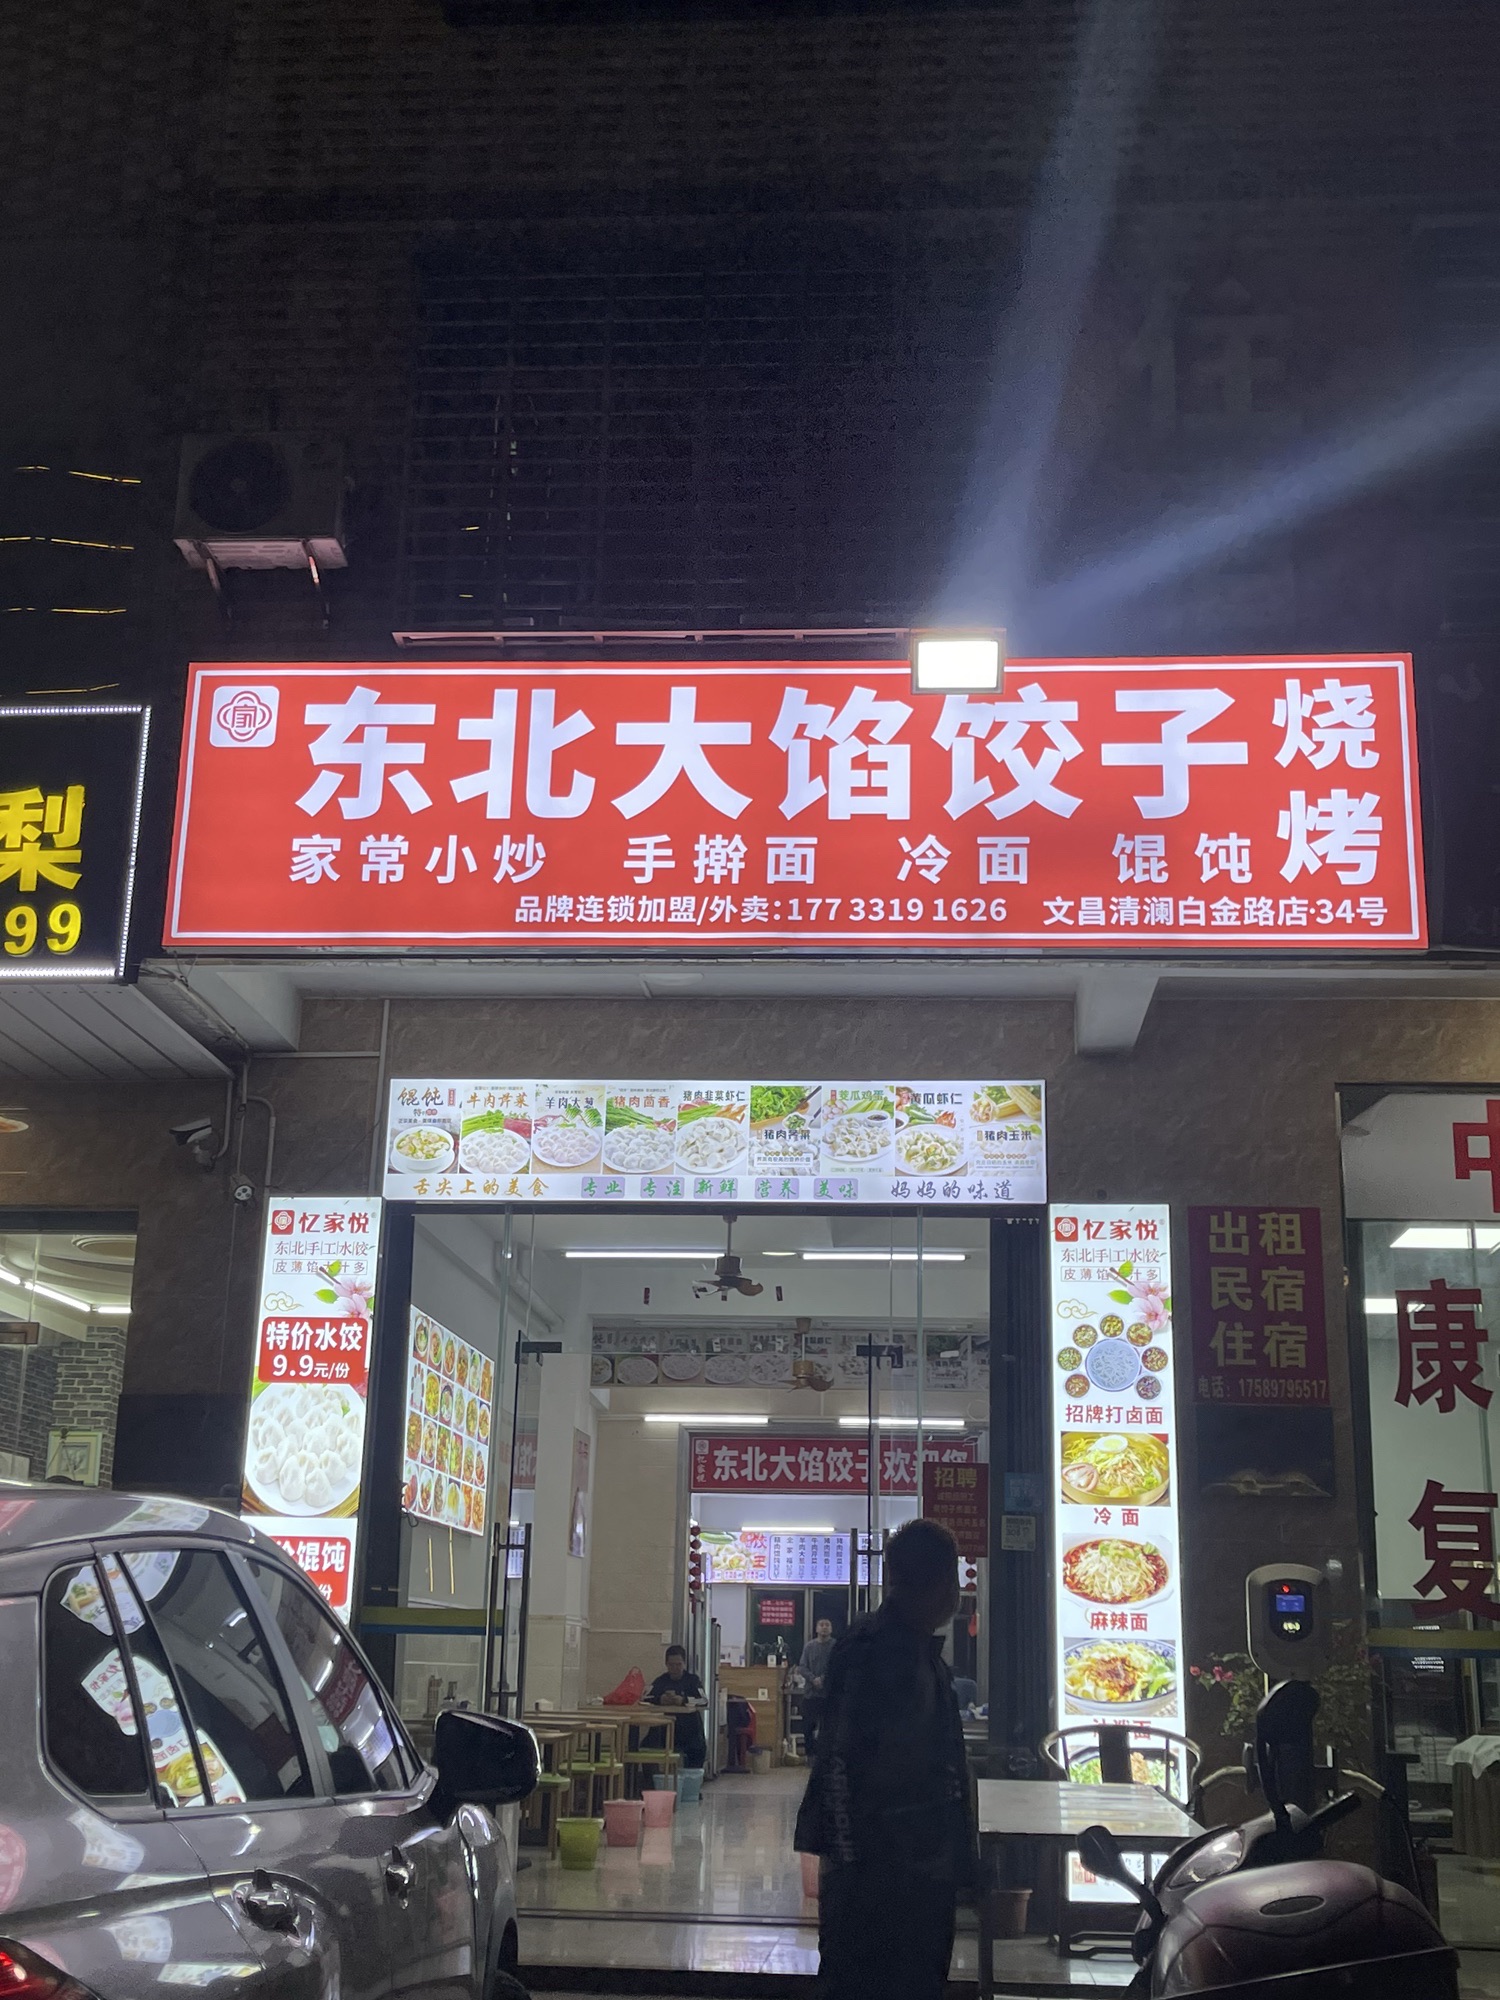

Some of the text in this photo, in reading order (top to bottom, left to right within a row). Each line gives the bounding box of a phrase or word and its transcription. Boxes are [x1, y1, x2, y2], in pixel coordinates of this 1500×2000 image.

[295, 686, 1249, 821] 东北大馅饺子
[1273, 678, 1383, 886] 烧烤
[290, 833, 1253, 885] 家常小炒 手擀面 冷面 馄饨
[849, 898, 924, 921] 3319
[932, 898, 1007, 921] 1626
[398, 1087, 444, 1107] 馄饨
[467, 1092, 530, 1109] 牛肉芹菜
[614, 1095, 670, 1109] 猪肉茴香
[683, 1090, 745, 1102] 猪肉韭菜虾仁
[910, 1092, 963, 1105] 黄瓜虾仁
[985, 1130, 1032, 1141] 猪肉玉米
[413, 1177, 549, 1198] 舌尖上的美食
[583, 1177, 857, 1199] 专业 专注 新鲜 营养 美味
[890, 1179, 1016, 1201] 妈妈的味道
[298, 1211, 370, 1234] 忆家悦
[1083, 1218, 1160, 1241] 忆家悦
[1208, 1211, 1306, 1256] 出租
[1209, 1266, 1307, 1312] 民宿
[265, 1320, 363, 1351] 特价水饺
[1208, 1320, 1308, 1368] 住宿
[272, 1353, 350, 1379] 9.9元/份
[1065, 1404, 1163, 1424] 招牌打卤面
[935, 1467, 977, 1488] 招聘
[1093, 1507, 1139, 1527] 冷面
[1090, 1612, 1148, 1632] 麻辣面
